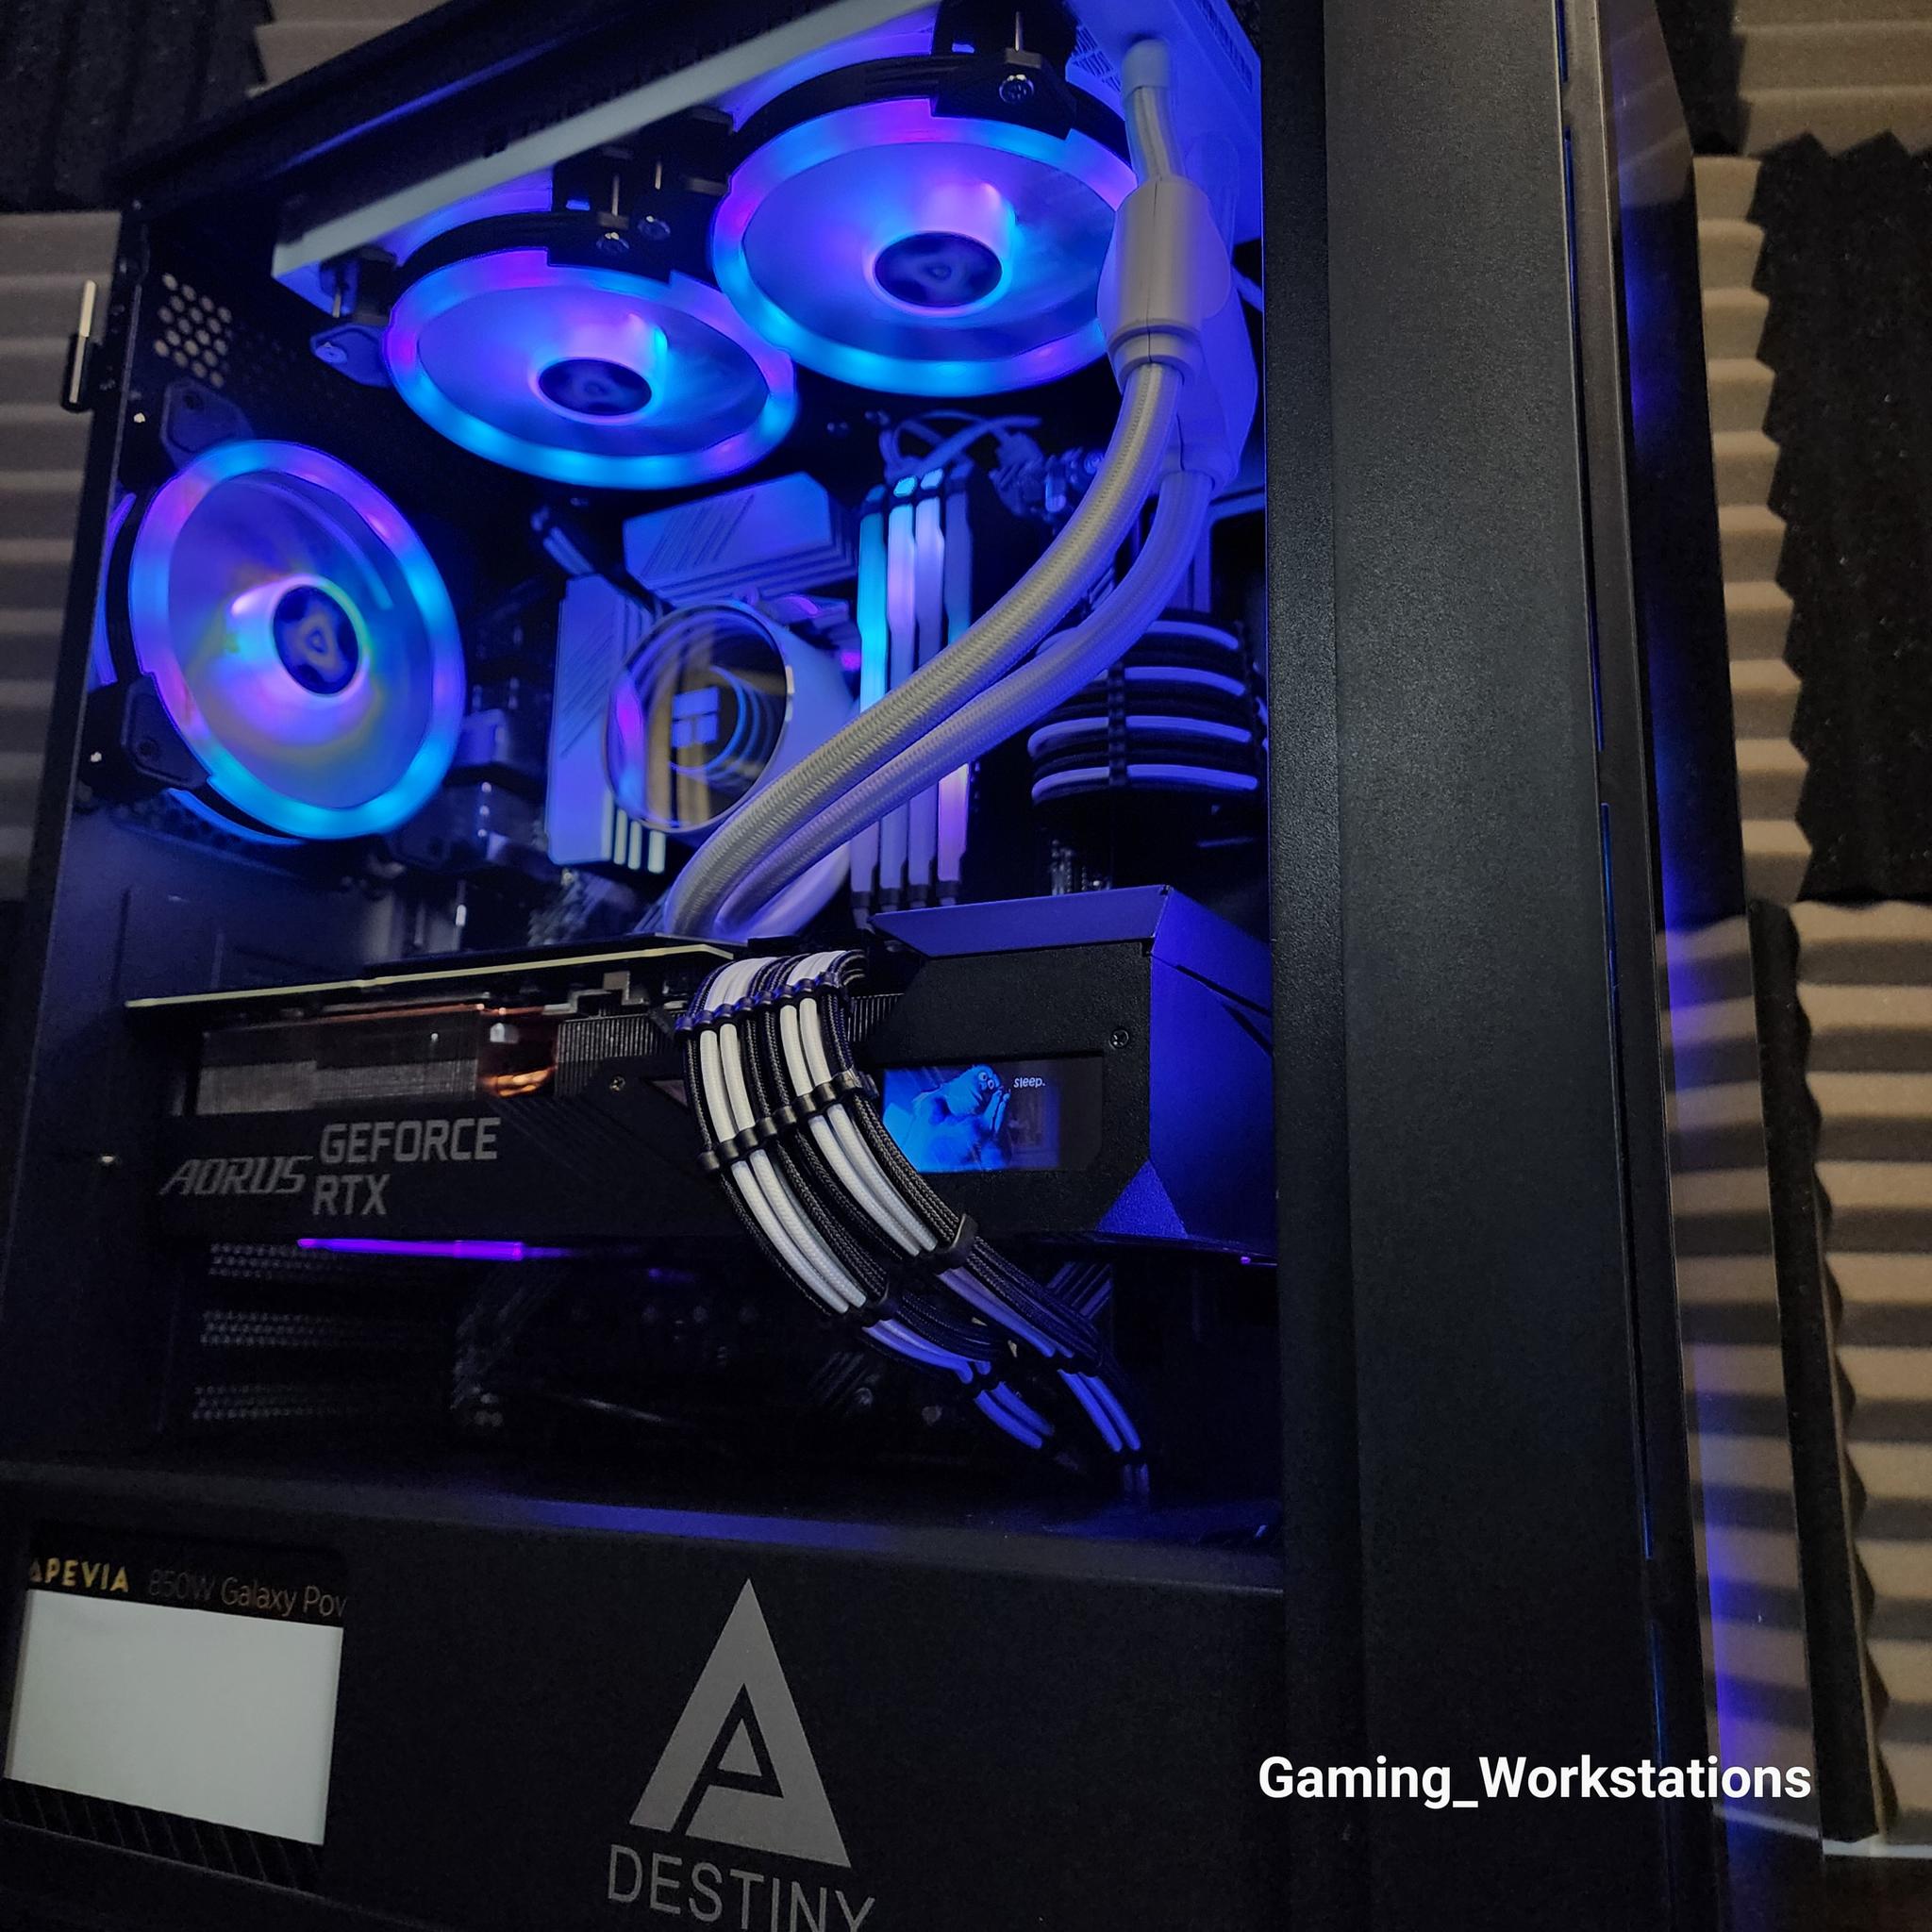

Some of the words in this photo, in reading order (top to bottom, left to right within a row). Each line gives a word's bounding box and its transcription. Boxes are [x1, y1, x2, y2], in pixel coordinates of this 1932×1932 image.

[1013, 1075, 1046, 1089] sleep.
[320, 1117, 501, 1164] GEFORCE
[158, 1155, 315, 1195] AORUS
[311, 1174, 391, 1216] RTX
[29, 1557, 130, 1592] APEVIA
[148, 1569, 215, 1601] 850W
[220, 1576, 296, 1617] Galaxy
[608, 1843, 876, 1932] DESTINY
